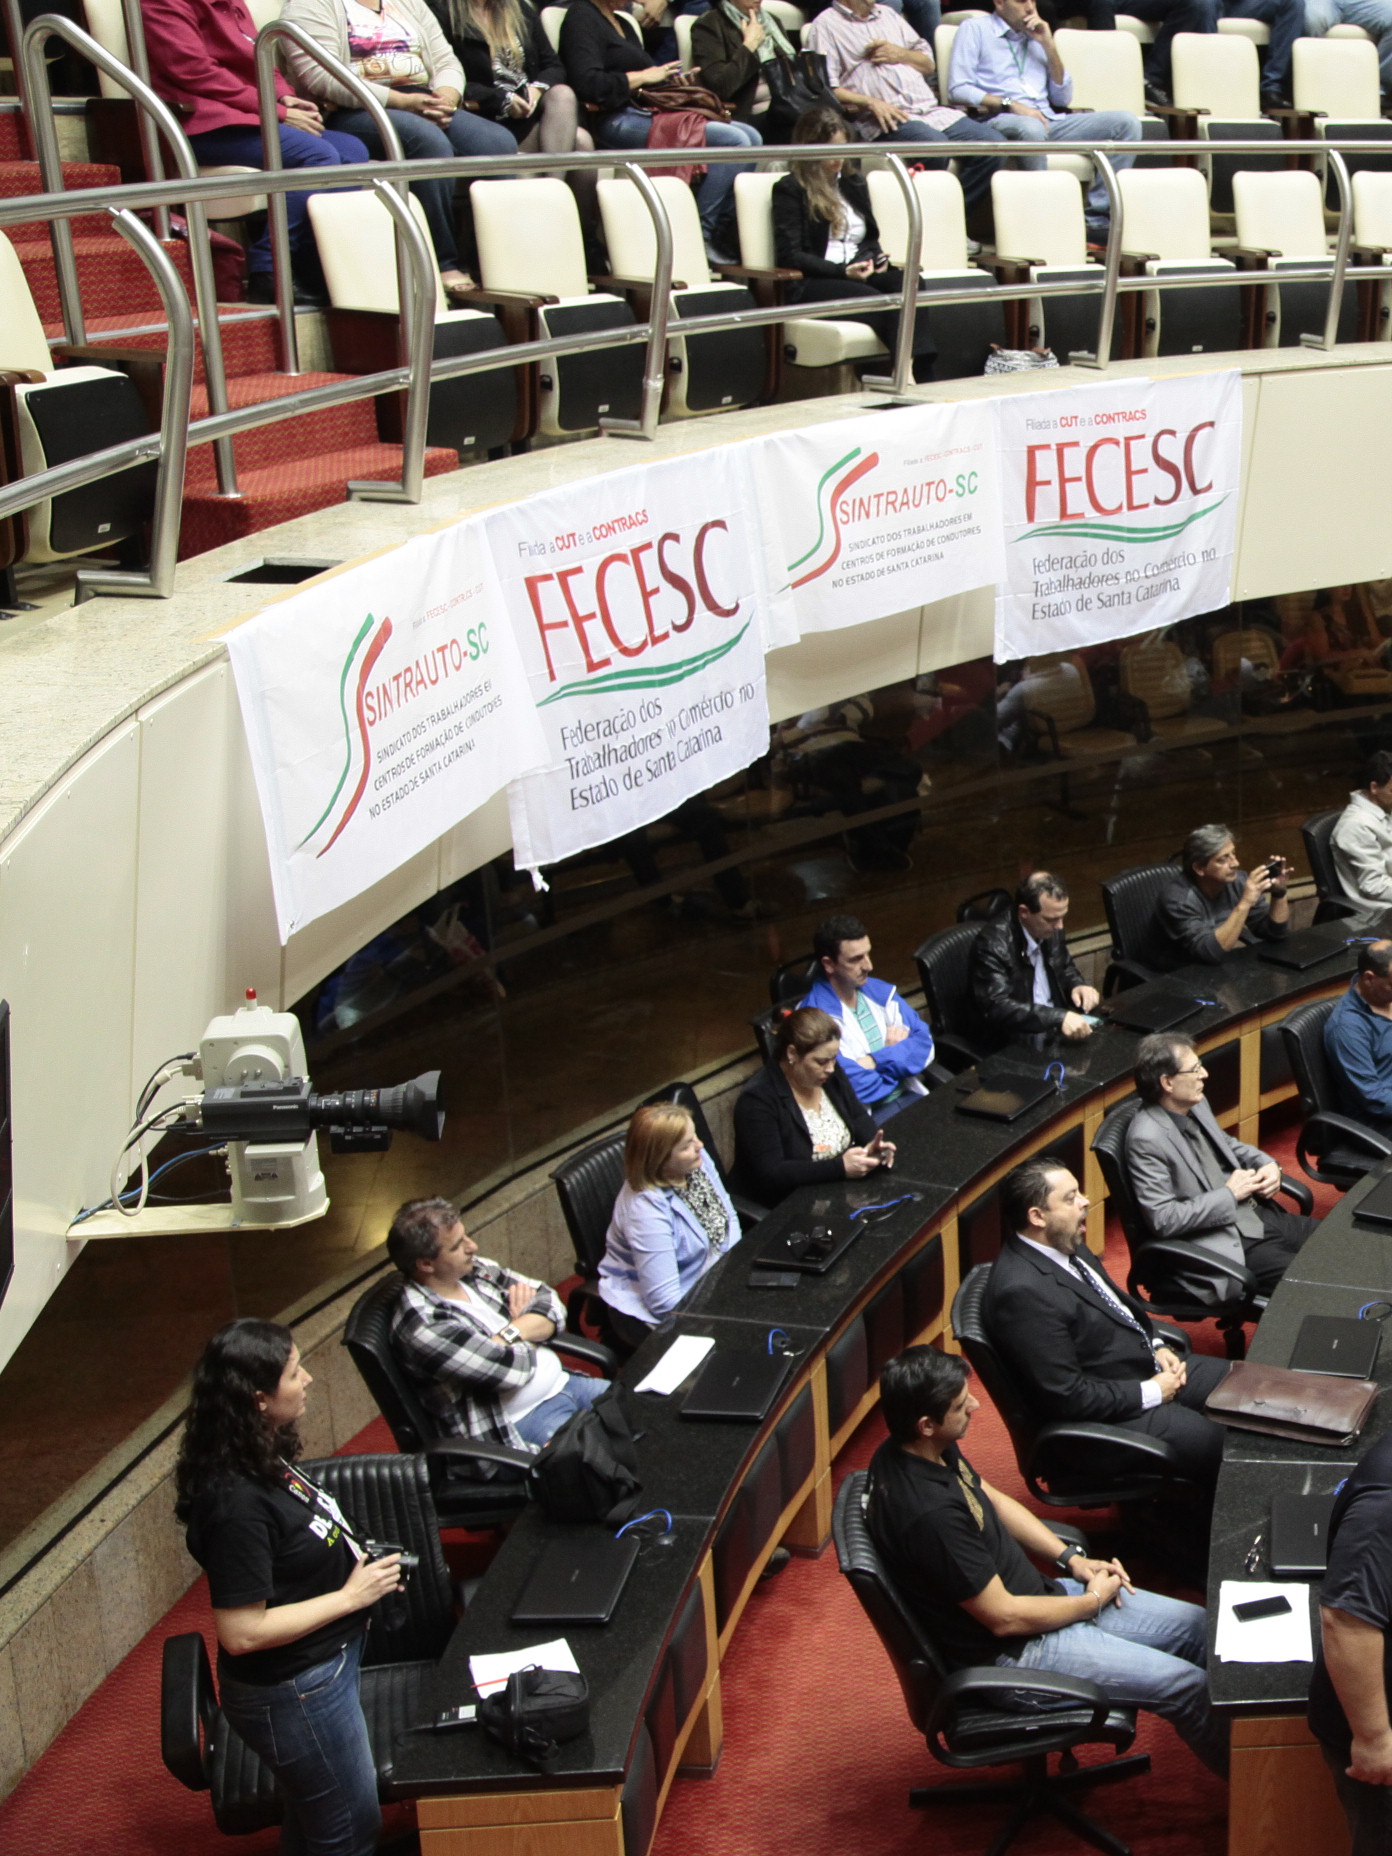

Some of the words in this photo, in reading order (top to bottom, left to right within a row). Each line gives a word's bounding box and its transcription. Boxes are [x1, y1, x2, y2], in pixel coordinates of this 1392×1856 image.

[1052, 420, 1058, 429] a
[1059, 415, 1079, 428] CUT
[1079, 418, 1086, 427] e
[1087, 416, 1094, 426] a
[1094, 409, 1147, 425] CONTRACS
[839, 470, 979, 525] SINTRAUTO-SC
[1025, 421, 1216, 524] FECESC
[549, 542, 556, 553] a
[555, 532, 577, 551] CUT
[578, 533, 585, 545] e
[585, 532, 593, 544] a
[592, 509, 649, 541] CONTRACS
[841, 553, 875, 571] CENTROS
[875, 550, 885, 560] DE
[886, 539, 925, 558] FORMAÇÃO
[926, 537, 936, 548] DE
[936, 525, 982, 545] CONDUTORES
[848, 535, 886, 553] SINDICATO
[886, 529, 902, 542] DOS
[903, 514, 962, 537] TRABALHADORES
[962, 512, 973, 522] EM
[832, 576, 844, 589] NO
[845, 570, 875, 586] ESTADO
[876, 567, 886, 578] DE
[886, 562, 910, 576] SANTA
[910, 551, 945, 568] CATARINA
[1033, 549, 1097, 575] Federação
[1101, 547, 1125, 566] dos
[1033, 570, 1120, 598] Trabalhadores
[1125, 568, 1140, 584] no
[1144, 551, 1197, 578] Comércio
[1201, 546, 1217, 562] no
[524, 519, 740, 682] FECESC
[1032, 602, 1072, 621] Estado
[1075, 594, 1093, 612] de
[1097, 590, 1132, 610] Santa
[1135, 577, 1180, 603] Catarina
[364, 621, 489, 727] SINTRAUTO-SC
[377, 731, 412, 764] SINDICATO
[411, 721, 427, 740] DOS
[560, 707, 636, 750] Federação
[639, 697, 663, 723] dos
[565, 728, 663, 780] Trabalhadores
[739, 683, 755, 704] no
[374, 761, 406, 791] CENTROS
[405, 753, 416, 769] DE
[454, 721, 464, 736] DE
[570, 775, 619, 811] Estado
[622, 766, 644, 791] de
[645, 751, 677, 782] Santa
[677, 724, 723, 763] Catarina
[369, 803, 380, 820] NO
[381, 783, 410, 811] ESTADO
[419, 760, 442, 785] SANTA
[288, 1484, 310, 1504] Canon
